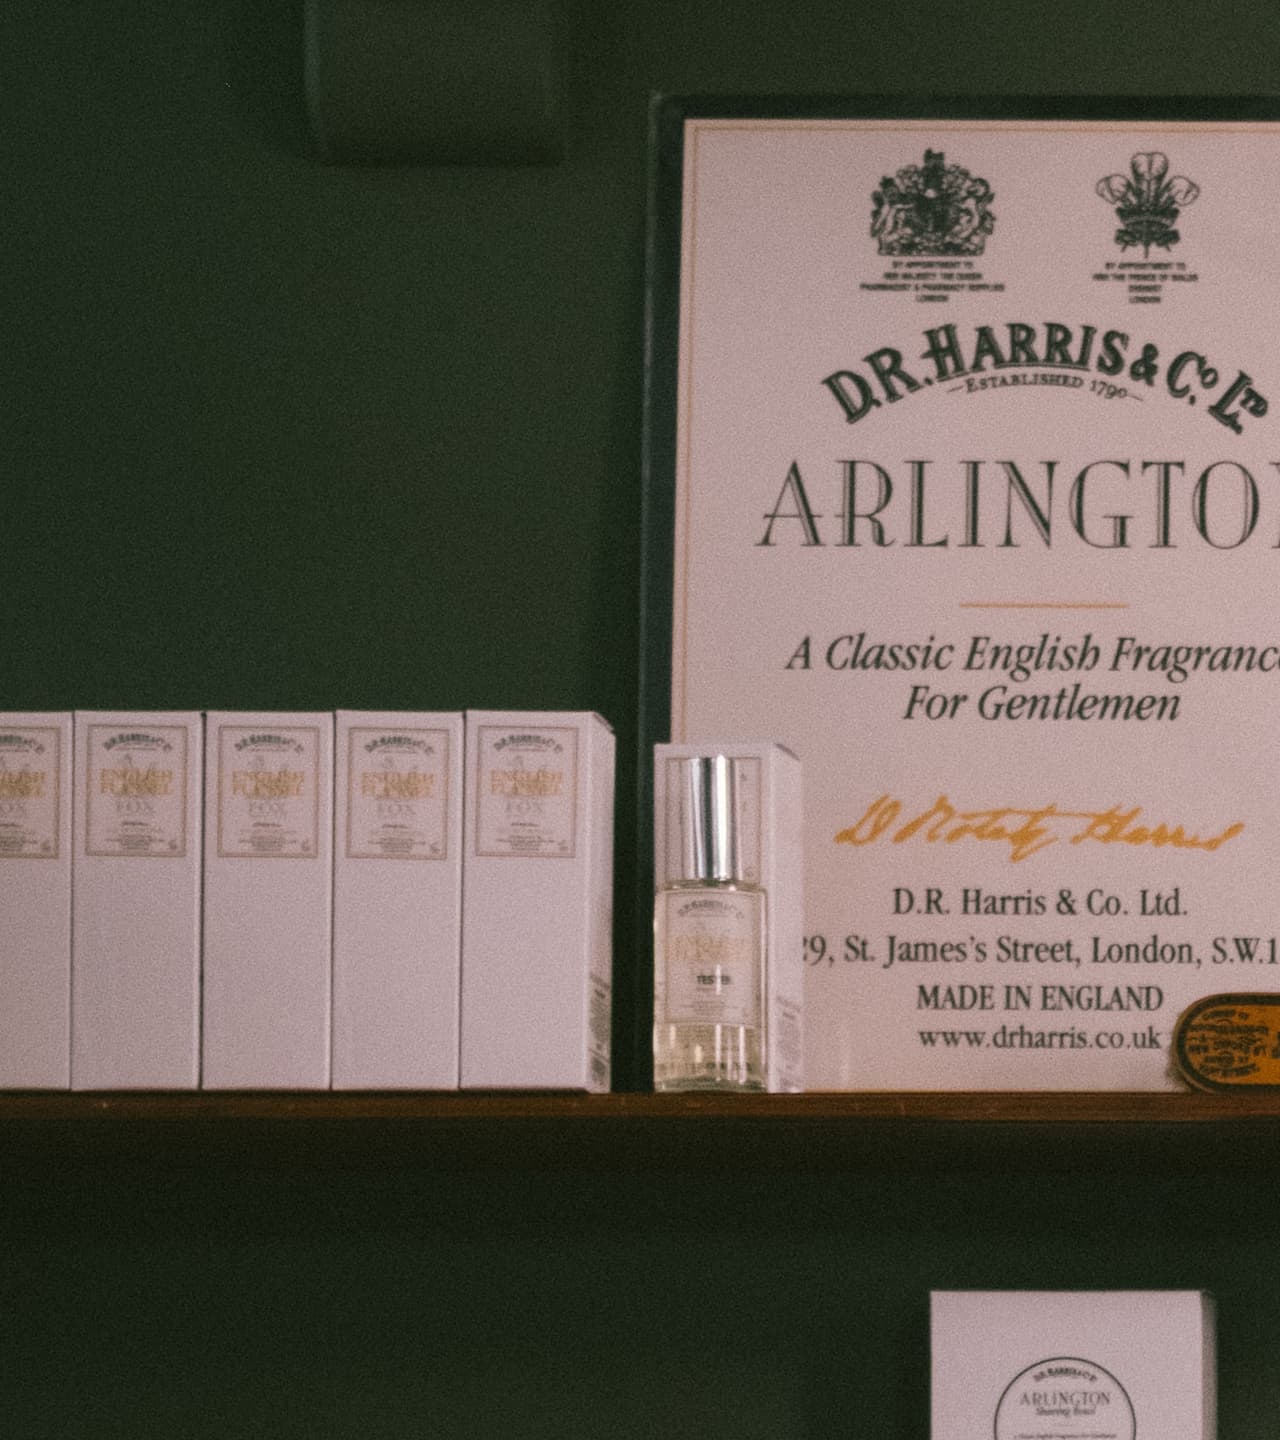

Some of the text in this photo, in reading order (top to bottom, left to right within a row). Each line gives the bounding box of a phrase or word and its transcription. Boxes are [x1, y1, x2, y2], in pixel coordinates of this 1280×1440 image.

[785, 637, 814, 672] A
[824, 635, 955, 673] Classic
[962, 635, 1101, 683] English
[903, 684, 1182, 724] For Gentlemen
[892, 888, 1189, 916] D.R. Harris & Co. Ltd.
[845, 937, 876, 964] St.
[883, 937, 987, 968] James's
[997, 937, 1082, 968] Street,
[1091, 937, 1203, 969] London,
[916, 986, 1164, 1012] MADE IN ENGLAND
[919, 1023, 1162, 1051] www.drharris.co.uk
[1020, 1392, 1111, 1406] ARLINGTON
